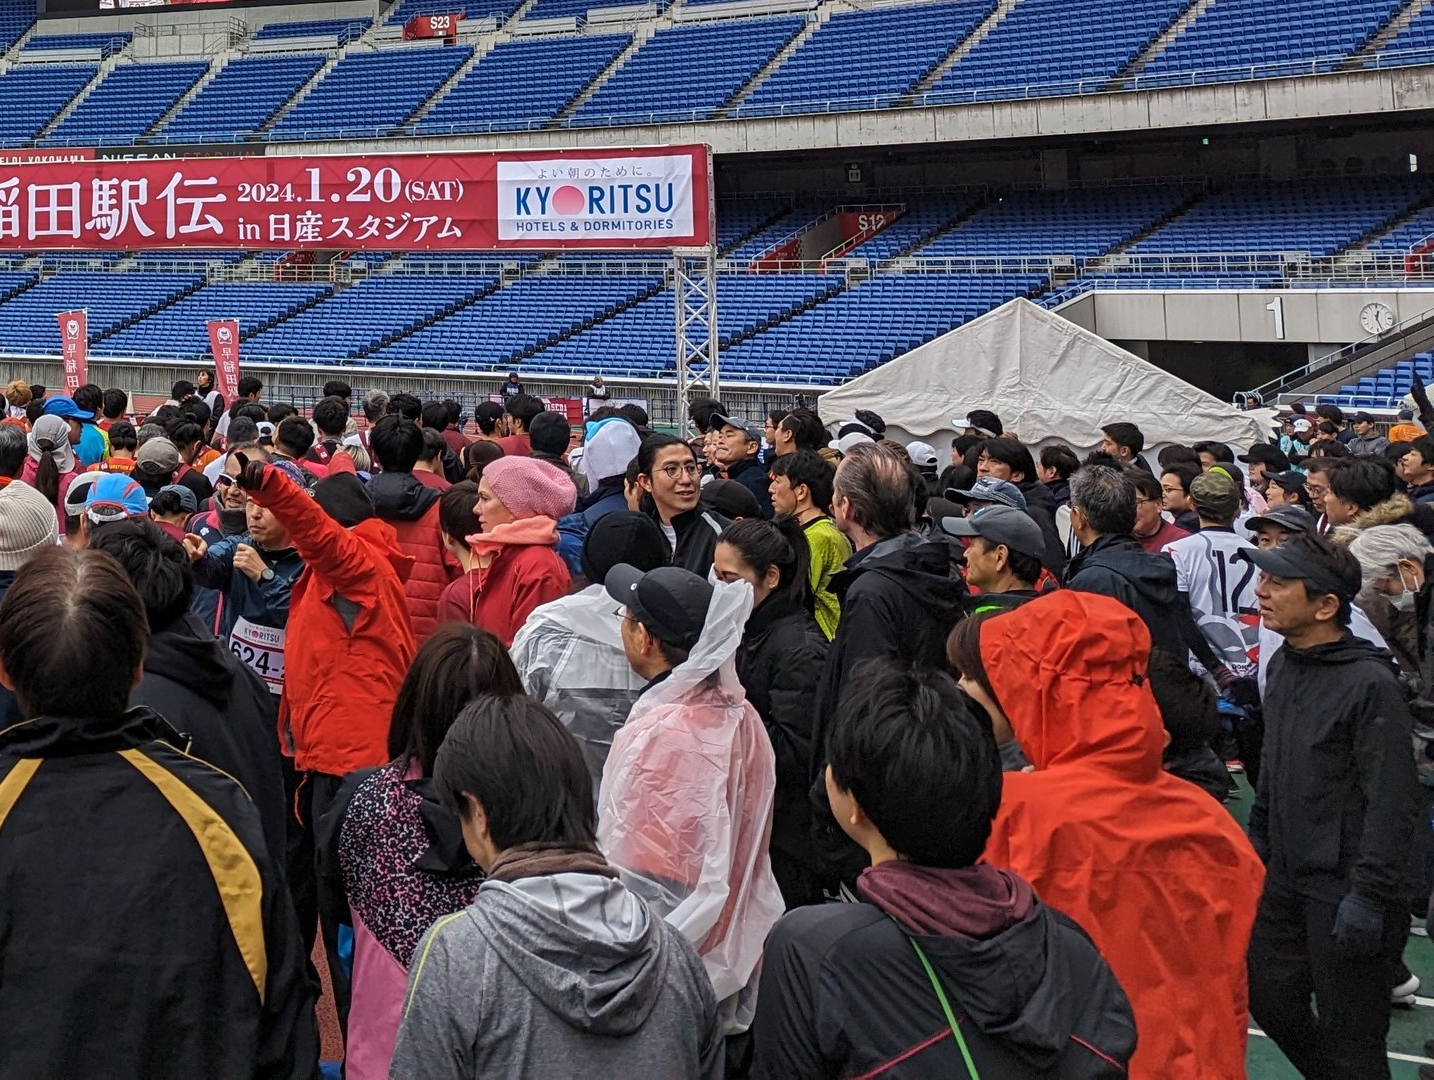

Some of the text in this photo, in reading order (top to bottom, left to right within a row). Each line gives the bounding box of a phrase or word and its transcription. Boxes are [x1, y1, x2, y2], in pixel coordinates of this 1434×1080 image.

[430, 15, 450, 30] S23
[537, 165, 652, 180] よい朝のために。
[237, 209, 463, 243] in 日産スタジアム
[516, 219, 674, 232] HOTELS & DORMITORIES
[1266, 296, 1285, 339] 1
